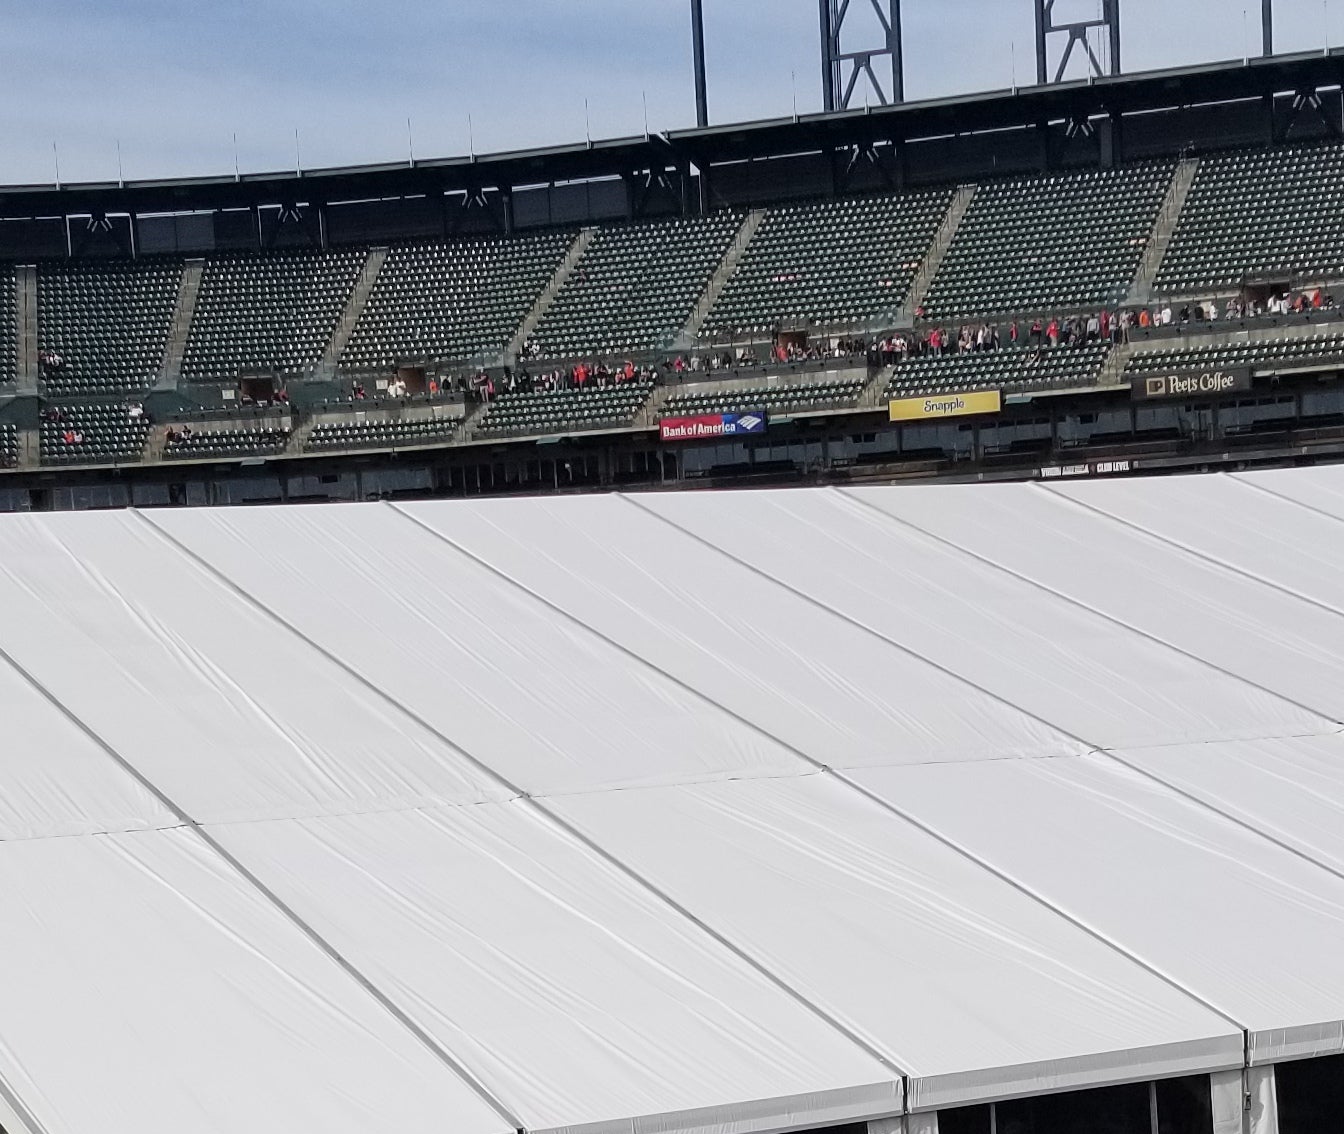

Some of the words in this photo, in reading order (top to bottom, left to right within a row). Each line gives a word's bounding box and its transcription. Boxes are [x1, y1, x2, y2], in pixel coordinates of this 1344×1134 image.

[1199, 372, 1234, 391] Coffee
[924, 398, 964, 414] Snapple
[663, 425, 686, 437] Bank
[687, 423, 697, 435] of
[698, 421, 736, 435] America
